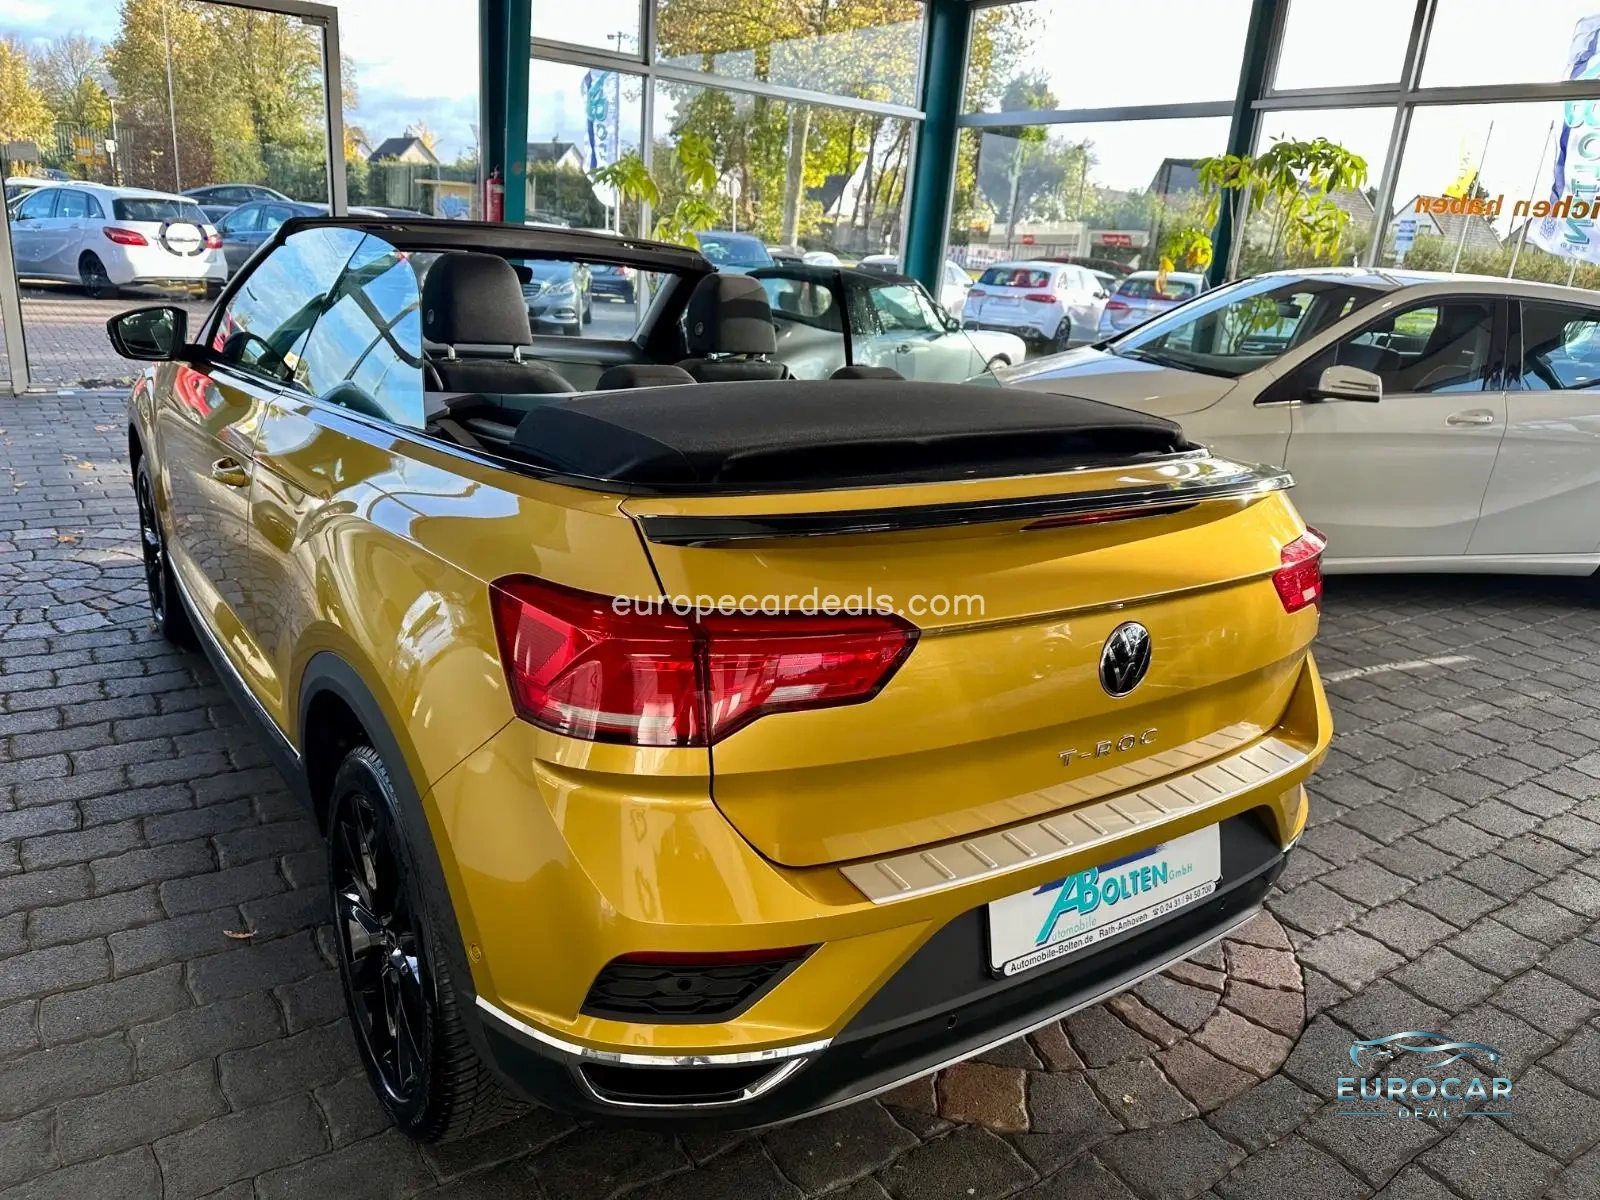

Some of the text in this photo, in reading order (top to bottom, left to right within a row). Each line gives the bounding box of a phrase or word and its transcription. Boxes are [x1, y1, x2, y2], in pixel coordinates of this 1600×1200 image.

[1058, 728, 1158, 767] T-ROC
[1169, 863, 1193, 880] GmbH
[1010, 934, 1094, 973] Automobile-Bolten.de
[1099, 913, 1148, 938] Rath-Anhoven
